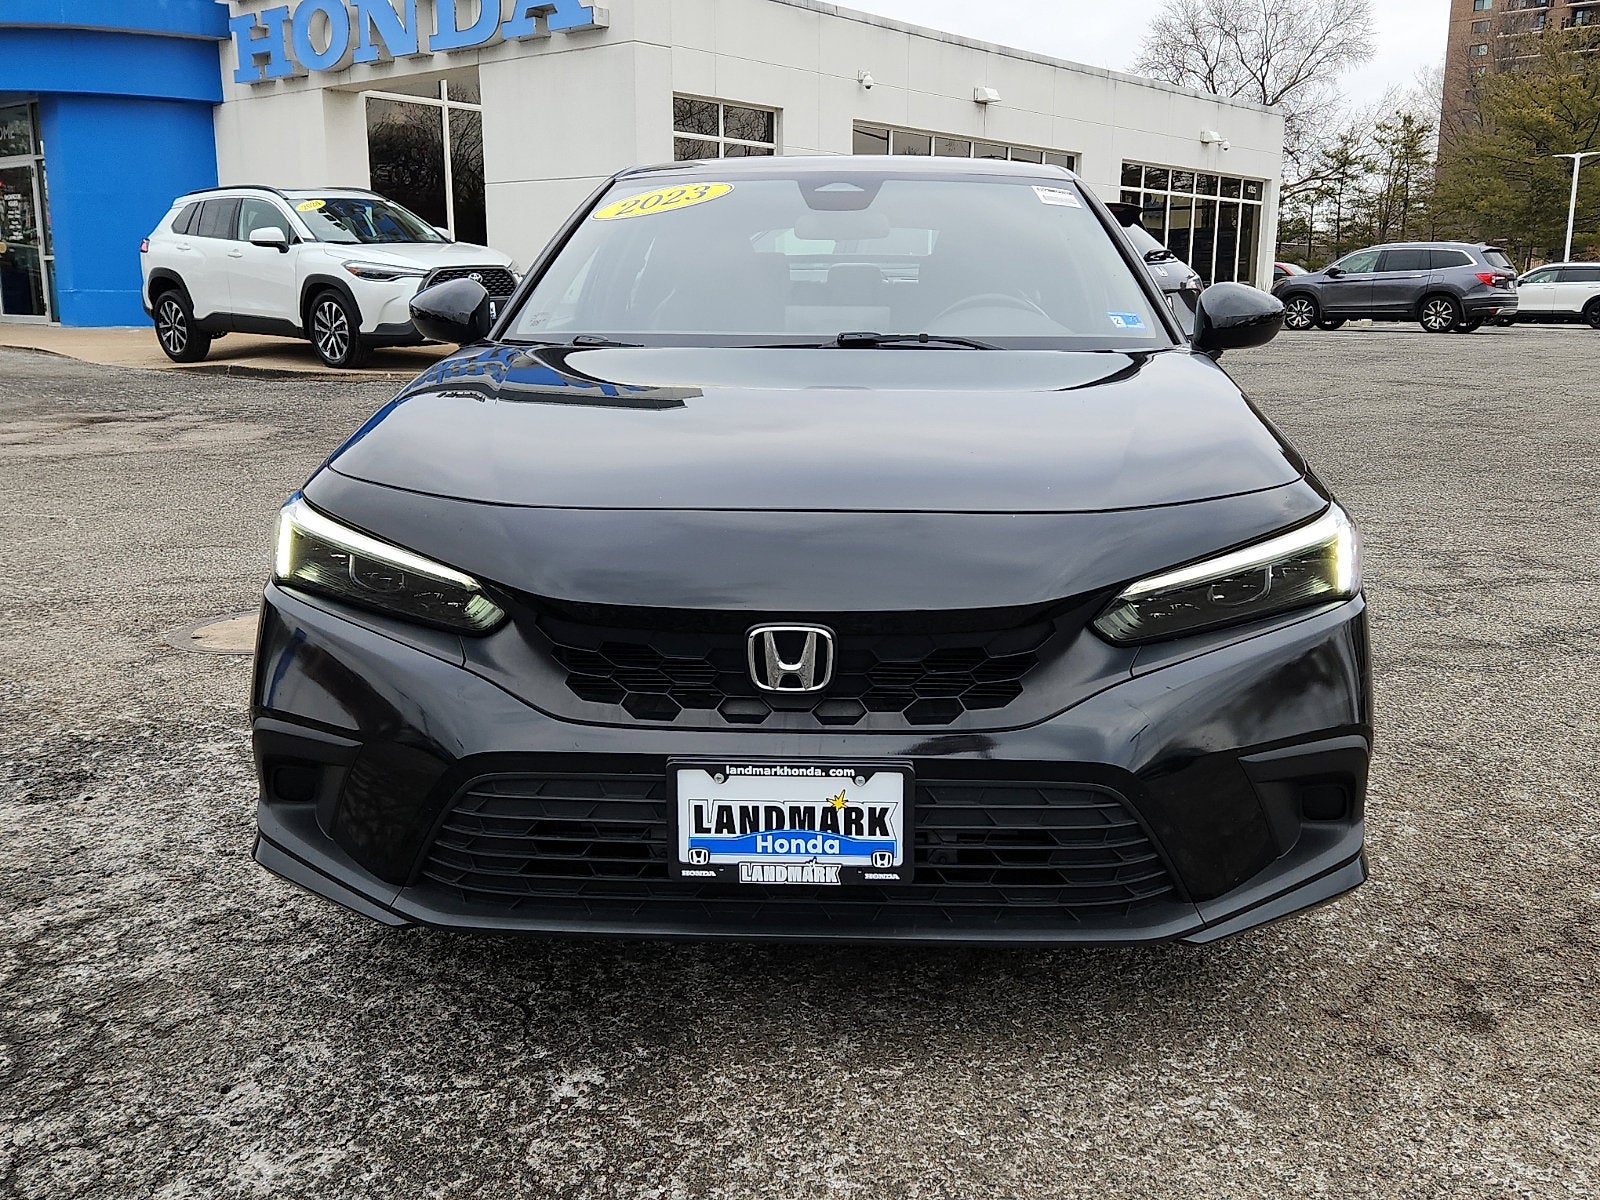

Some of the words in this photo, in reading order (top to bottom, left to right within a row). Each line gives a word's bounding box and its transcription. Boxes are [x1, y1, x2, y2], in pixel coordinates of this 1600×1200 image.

[614, 185, 711, 217] 2023
[693, 804, 891, 837] LANDMARK
[756, 834, 840, 854] Honda
[681, 869, 717, 877] HONDA
[740, 864, 840, 884] LANDMARK
